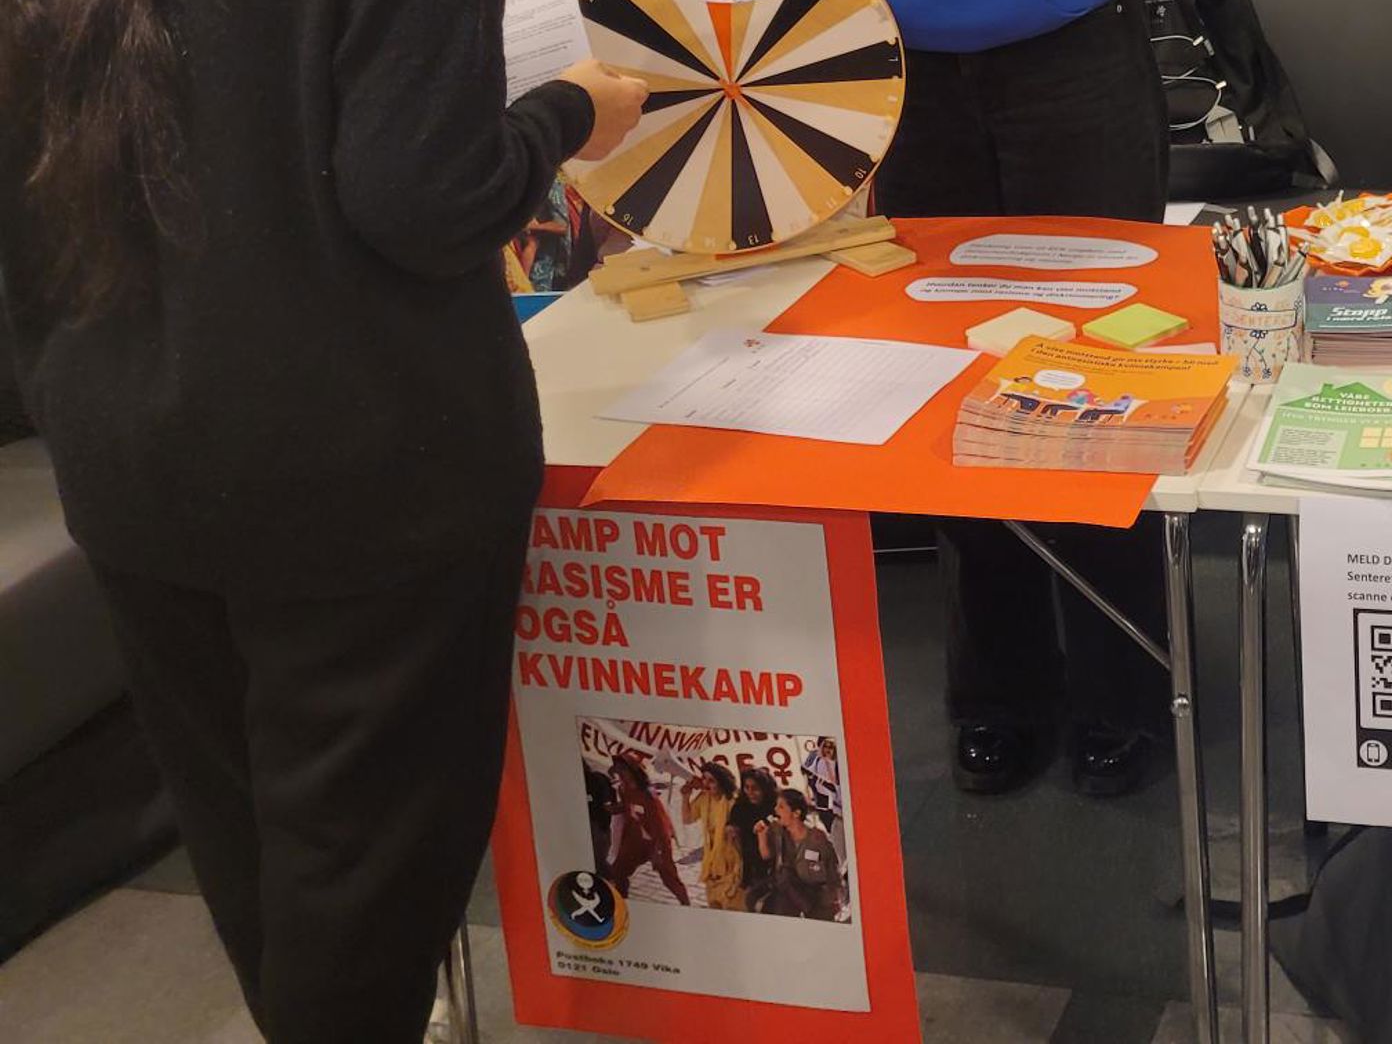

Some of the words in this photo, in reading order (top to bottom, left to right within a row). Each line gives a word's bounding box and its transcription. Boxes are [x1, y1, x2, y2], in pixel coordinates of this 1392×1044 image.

[854, 166, 868, 180] 10
[747, 233, 760, 246] 13
[1330, 306, 1388, 318] Stopp
[531, 514, 621, 556] AMP
[633, 520, 727, 563] MOT
[1346, 553, 1382, 567] MELD
[706, 573, 764, 614] ER
[1346, 590, 1387, 604] scanne
[515, 597, 630, 648] OGSÅ
[519, 649, 805, 709] KVINNEKAMP
[652, 962, 682, 975] Vika
